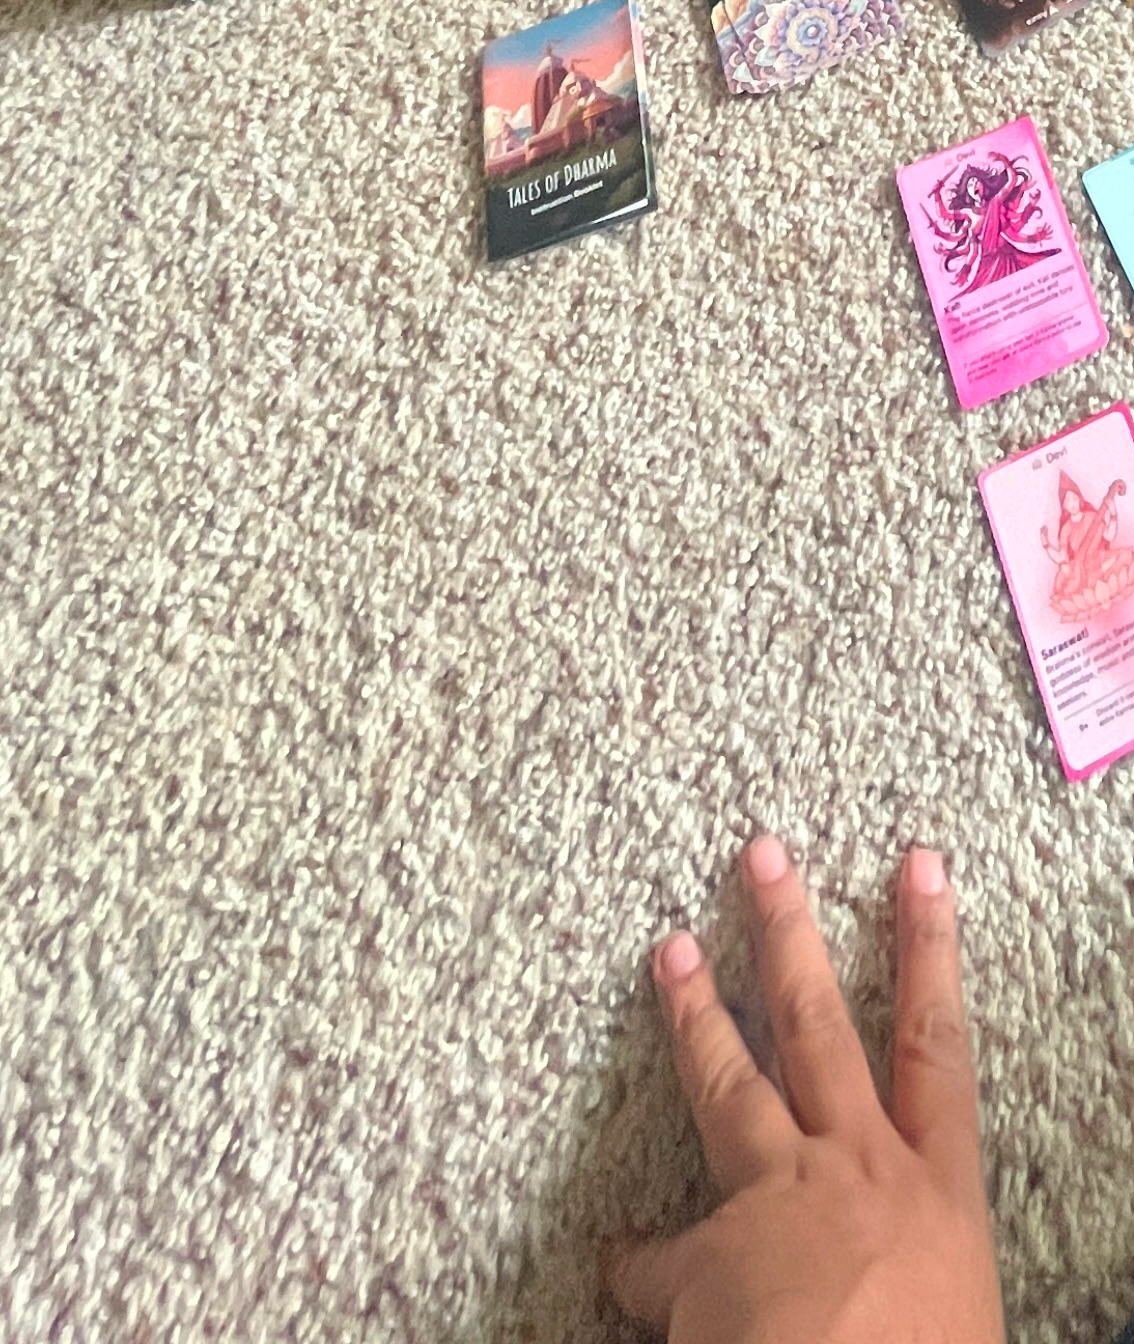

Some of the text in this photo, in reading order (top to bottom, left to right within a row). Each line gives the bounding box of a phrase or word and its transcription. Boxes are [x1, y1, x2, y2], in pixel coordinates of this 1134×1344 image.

[506, 148, 617, 208] TALES OF DHARMA
[1045, 446, 1068, 462] Devi
[1040, 628, 1089, 659] Saraswati
